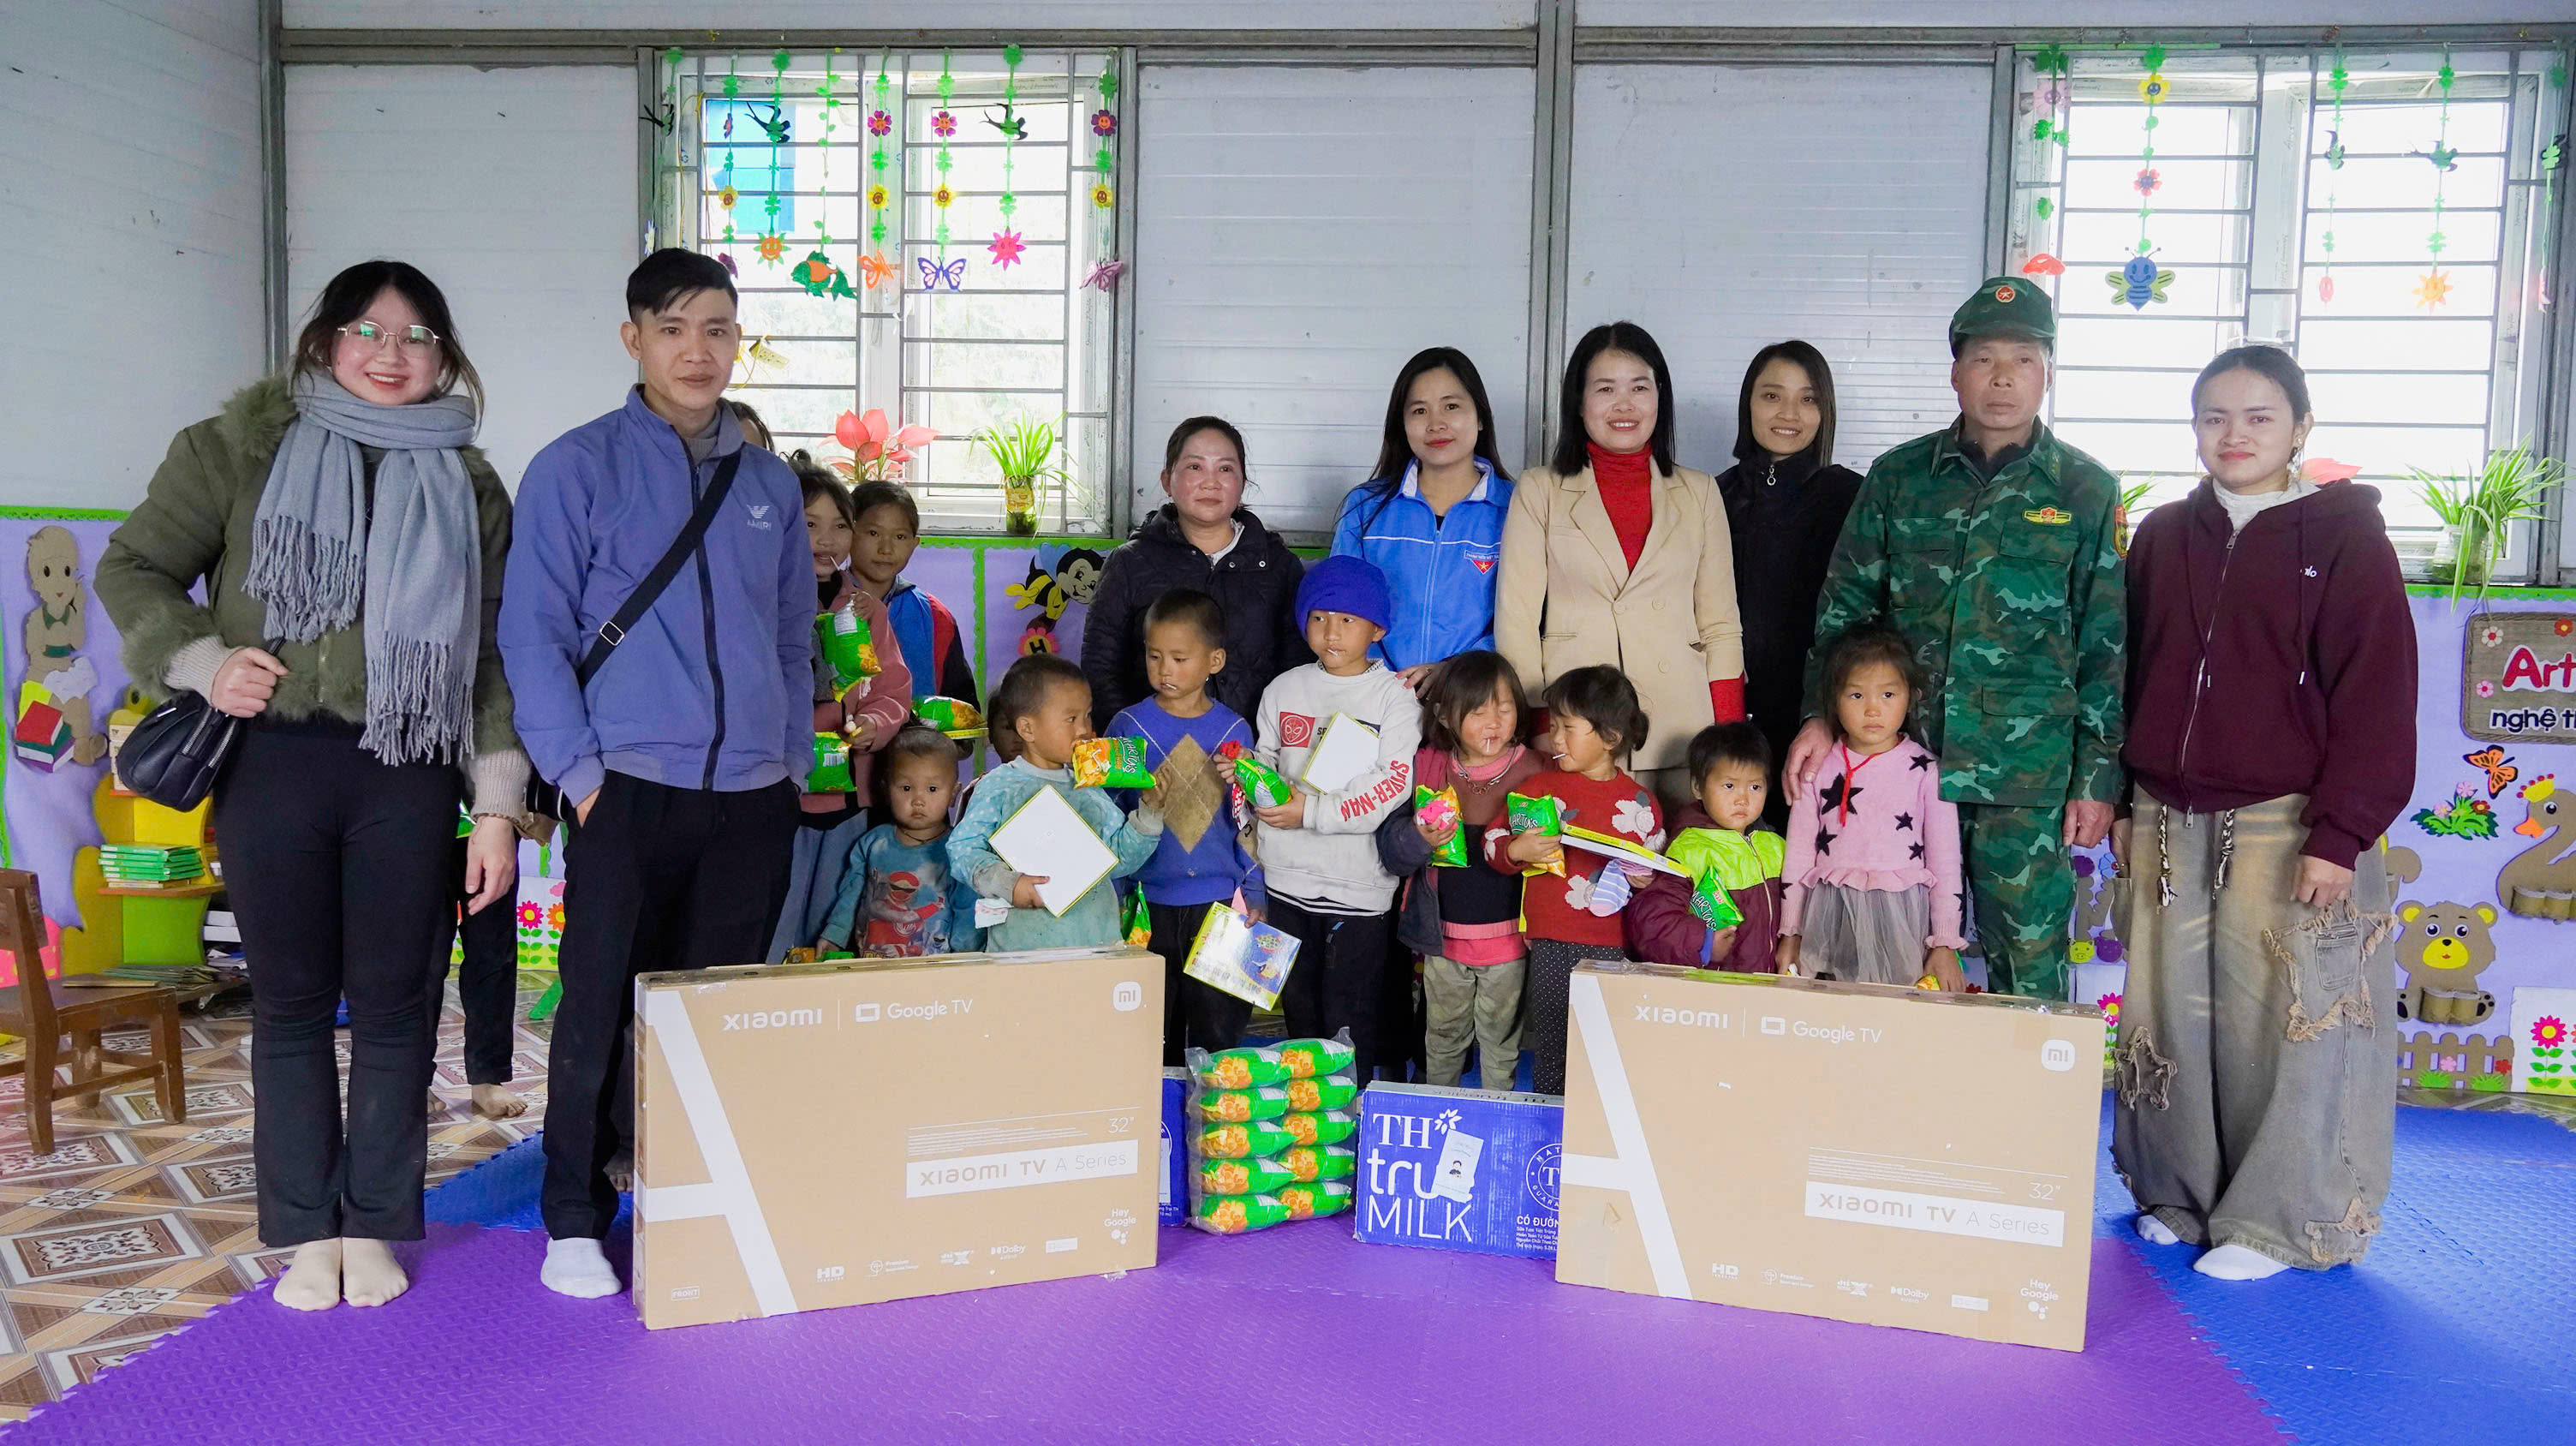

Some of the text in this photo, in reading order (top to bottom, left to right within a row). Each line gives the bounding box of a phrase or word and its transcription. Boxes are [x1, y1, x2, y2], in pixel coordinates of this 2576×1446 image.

[2502, 648, 2576, 688] Art
[2492, 708, 2556, 733] nghệ
[887, 1001, 948, 1020] Google
[951, 998, 974, 1015] TV
[1793, 1020, 1856, 1043] Google
[1859, 1027, 1883, 1043] TV
[1372, 1113, 1434, 1149] TH
[1020, 1159, 1046, 1176] TV
[1055, 1157, 1067, 1173] A
[1075, 1153, 1127, 1171] Series
[1367, 1148, 1447, 1200] tru
[1112, 1208, 1130, 1217] Hey
[1367, 1194, 1473, 1242] MILK
[1517, 1213, 1530, 1226] CÓ
[1926, 1205, 1957, 1223] TV
[1966, 1210, 1981, 1227] A
[1989, 1214, 2050, 1235] Series
[1103, 1216, 1137, 1228] Google
[1000, 1244, 1027, 1255] Dolby
[816, 1265, 845, 1280] HD
[1712, 1263, 1739, 1276] HD
[1903, 1288, 1929, 1300] Dolby
[2030, 1279, 2051, 1292] Hey
[2020, 1288, 2060, 1302] Google
